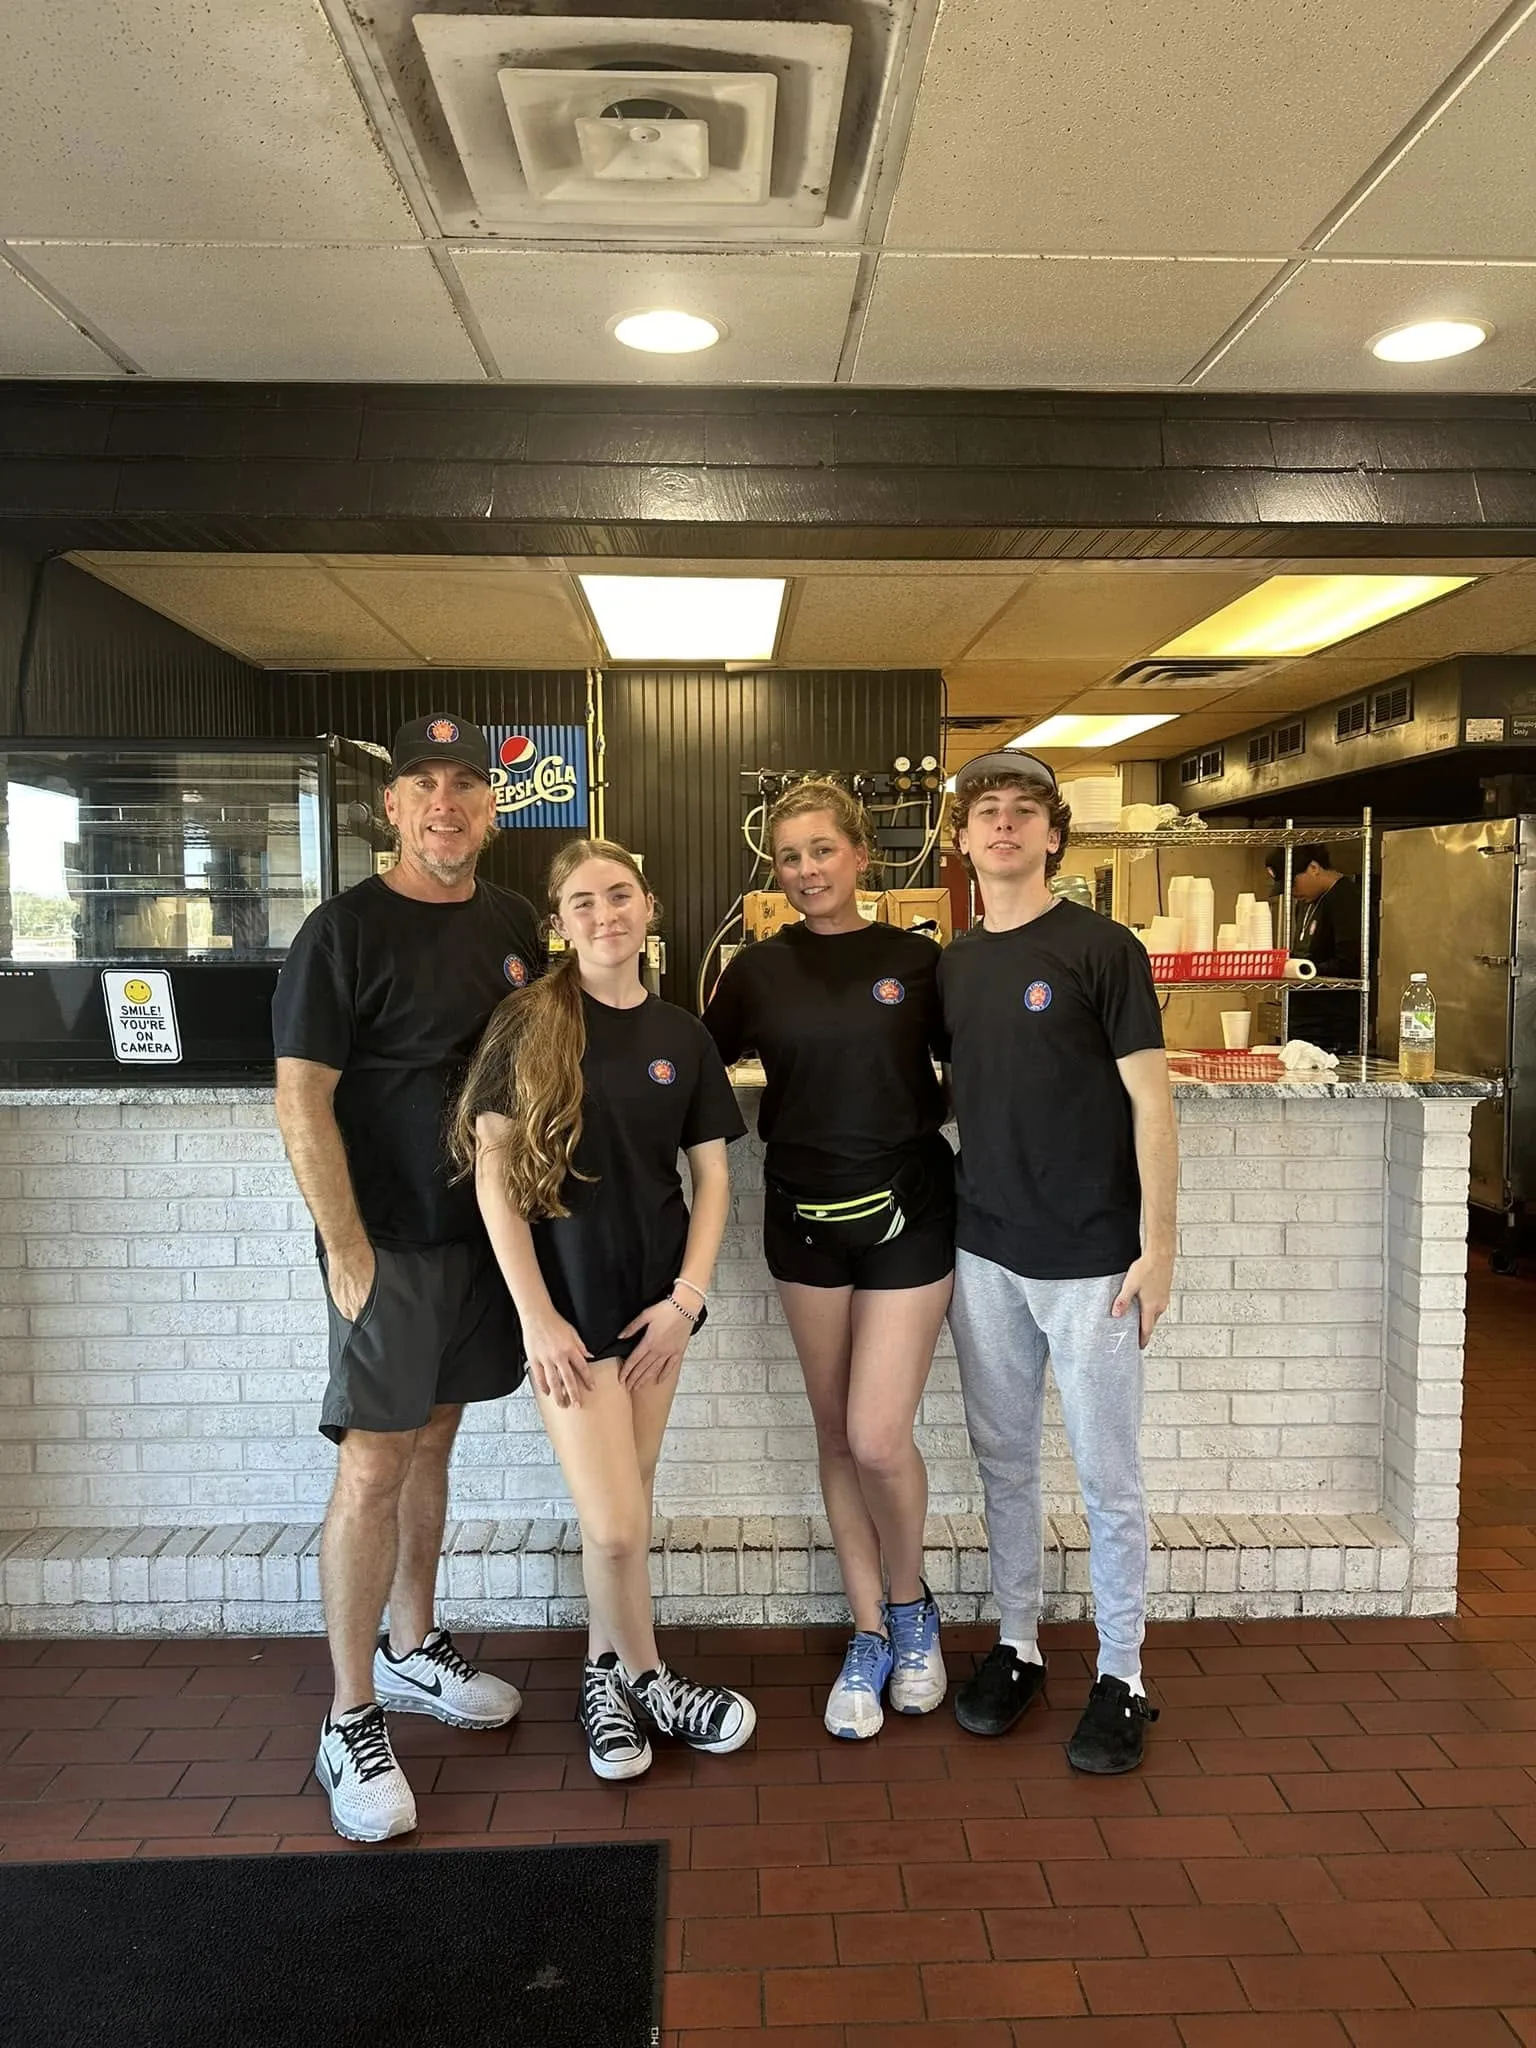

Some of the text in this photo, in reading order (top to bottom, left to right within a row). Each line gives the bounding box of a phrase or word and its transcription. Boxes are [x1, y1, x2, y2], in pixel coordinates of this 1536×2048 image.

[121, 1005, 161, 1016] SMILE!
[120, 1020, 166, 1030] YOU'RE
[136, 1032, 153, 1042] ON
[121, 1042, 172, 1053] CAMERA
